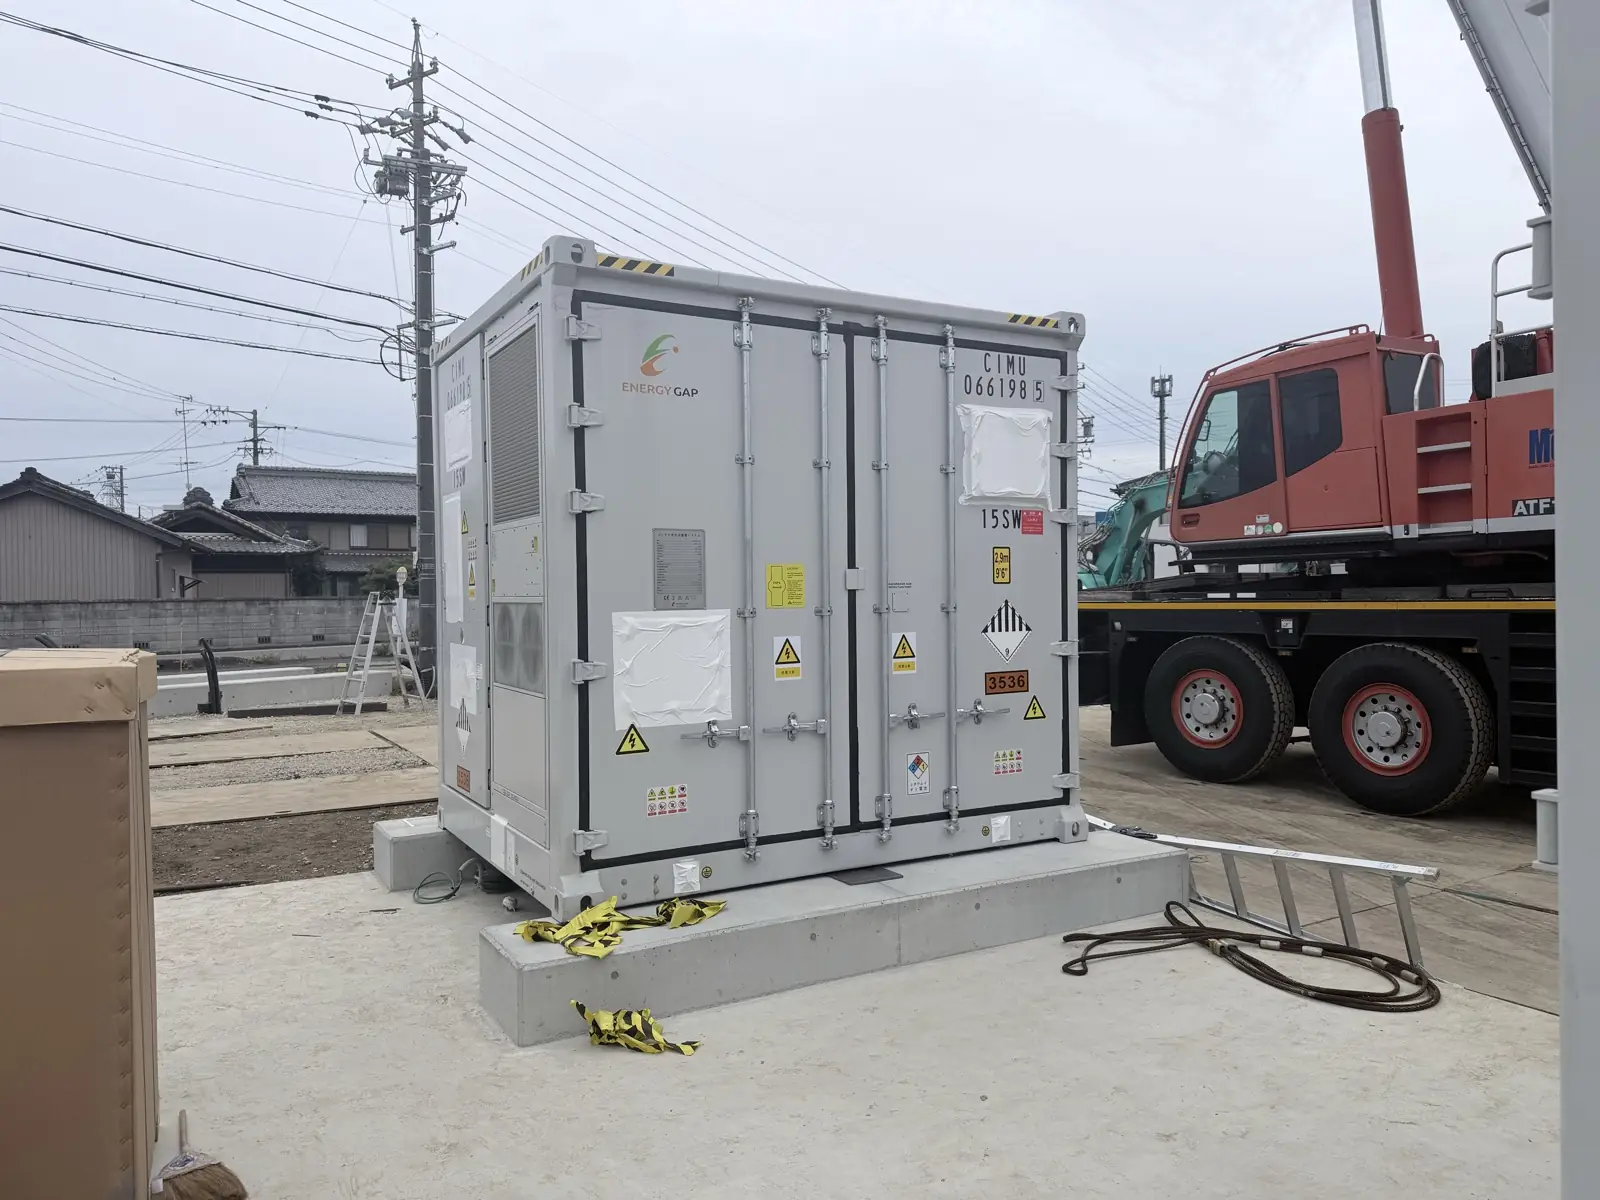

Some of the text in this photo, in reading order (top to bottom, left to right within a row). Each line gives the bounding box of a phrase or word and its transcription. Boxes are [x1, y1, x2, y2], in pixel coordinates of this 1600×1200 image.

[983, 352, 1026, 376] CIMU
[622, 382, 699, 398] ENERGY GAP
[964, 374, 1043, 401] 066198 5
[1513, 498, 1555, 516] ATF
[982, 508, 1021, 529] 15SW
[1005, 647, 1010, 657] 9
[988, 674, 1026, 690] 3536
